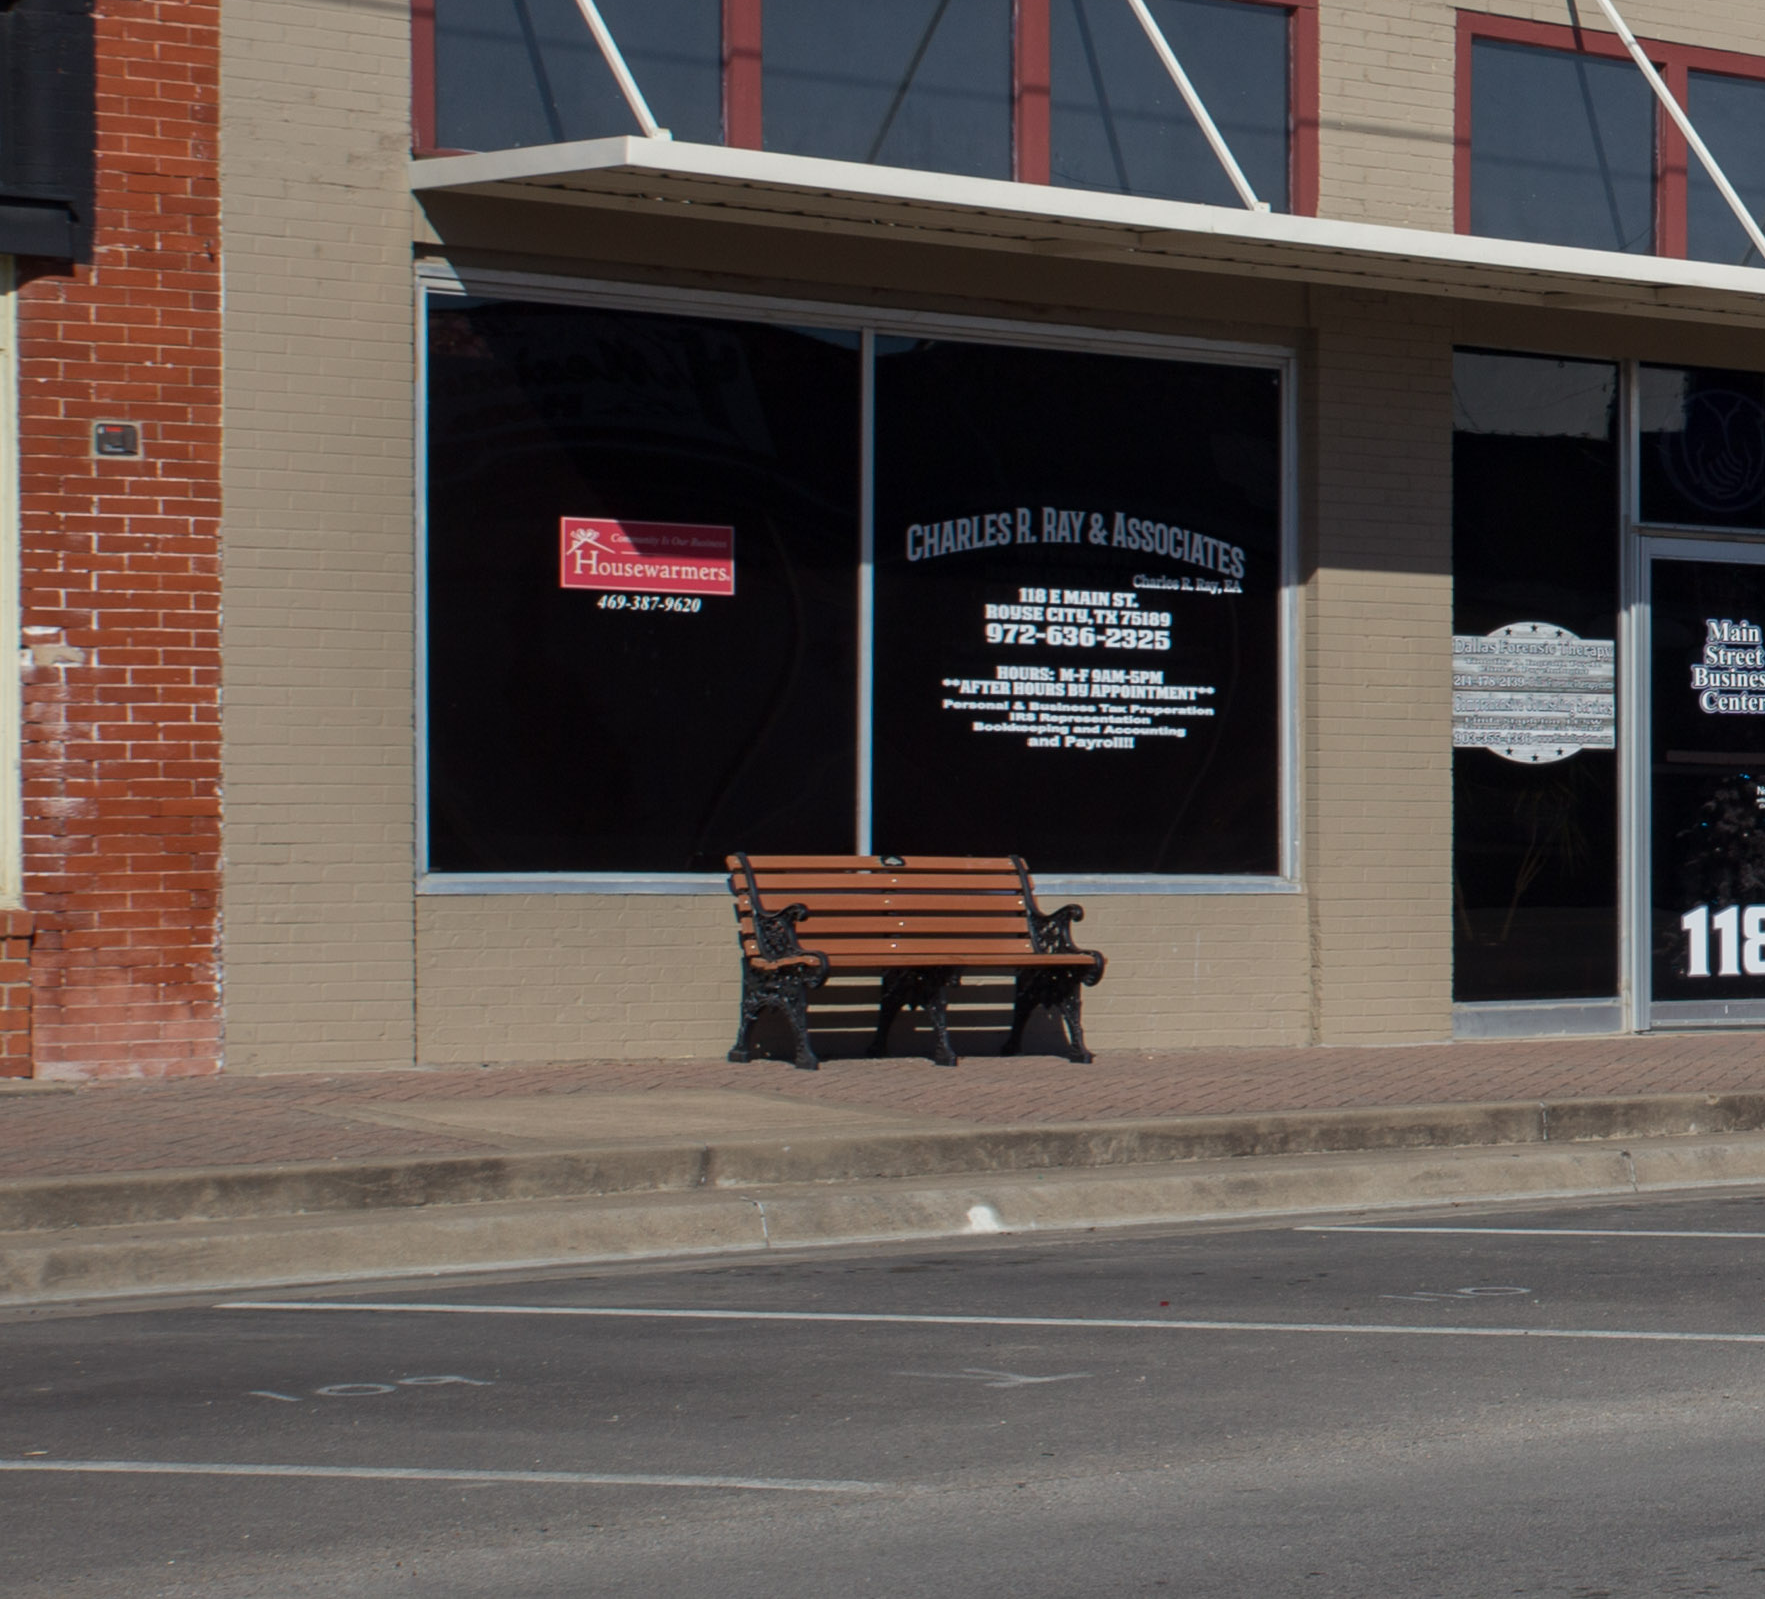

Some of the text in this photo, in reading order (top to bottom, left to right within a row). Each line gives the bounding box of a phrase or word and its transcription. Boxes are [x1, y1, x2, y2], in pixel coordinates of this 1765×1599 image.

[906, 507, 1246, 579] CHARLES R. RAY & ASSOCIATES
[1132, 574, 1180, 590] Charles
[1224, 578, 1243, 594] EA
[597, 594, 702, 613] 469-387-9620
[1018, 587, 1140, 609] 118 E MAIN ST.
[984, 603, 1044, 622] ROYSE
[1093, 609, 1119, 626] TX
[1120, 610, 1173, 628] 75189
[984, 622, 1172, 651] 972-636-2325
[1707, 620, 1762, 644] Main
[1454, 638, 1613, 661] Dallas Forensic Therapy
[1705, 645, 1765, 667] Street
[996, 665, 1164, 685] HOURS: M-F 9AM-5PM
[1012, 681, 1066, 697] HOURS
[1067, 683, 1089, 699] BY
[942, 699, 1010, 711] Personal
[1028, 701, 1097, 713] Business
[1099, 703, 1128, 714] Tax
[1009, 711, 1152, 725] IRS Representation
[972, 721, 1187, 739] Bookkeeping and Accounting
[1026, 735, 1061, 748] and
